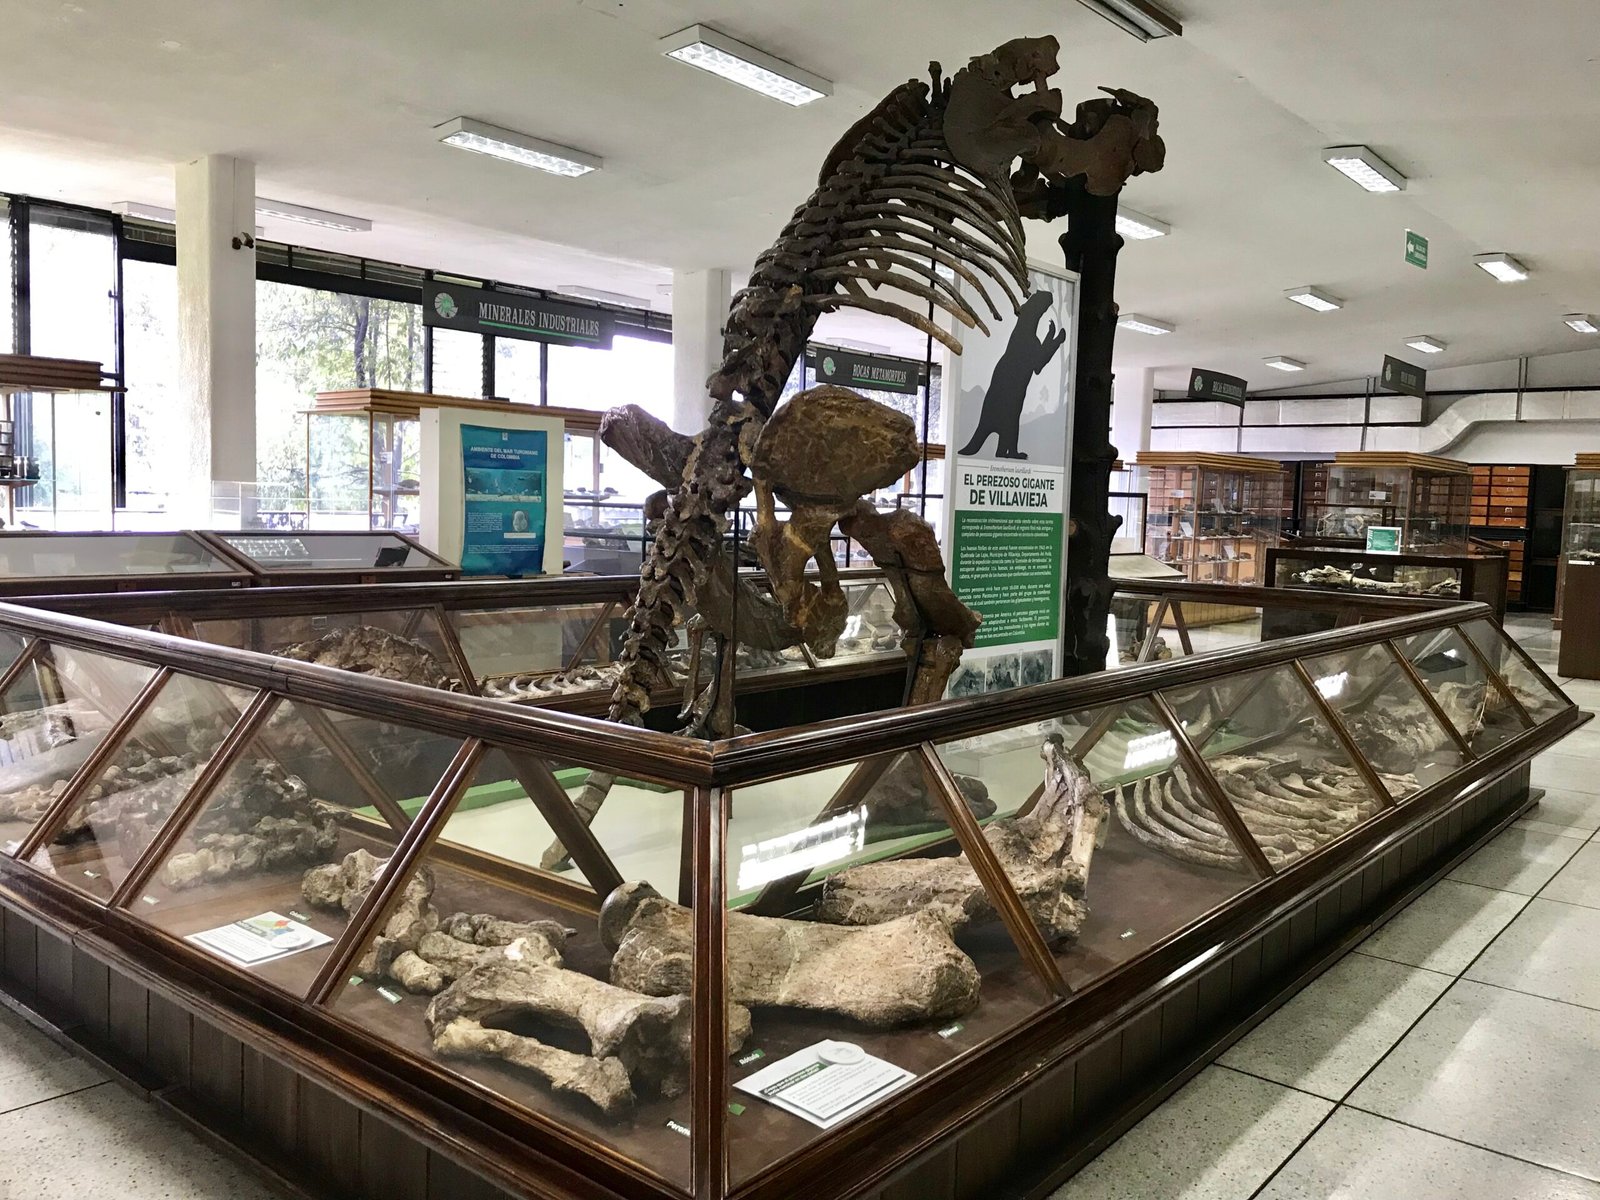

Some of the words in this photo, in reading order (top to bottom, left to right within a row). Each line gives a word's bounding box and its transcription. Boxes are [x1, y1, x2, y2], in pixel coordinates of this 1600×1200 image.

[479, 302, 536, 327] MINERALES
[538, 312, 600, 336] INDUSTRIALES
[852, 364, 870, 379] ROCAS
[964, 474, 974, 486] EL
[976, 474, 1020, 489] PEREZOSO
[1022, 478, 1055, 490] GIGANTE
[970, 489, 986, 505] DE
[988, 490, 1048, 508] VILLAVIEJA
